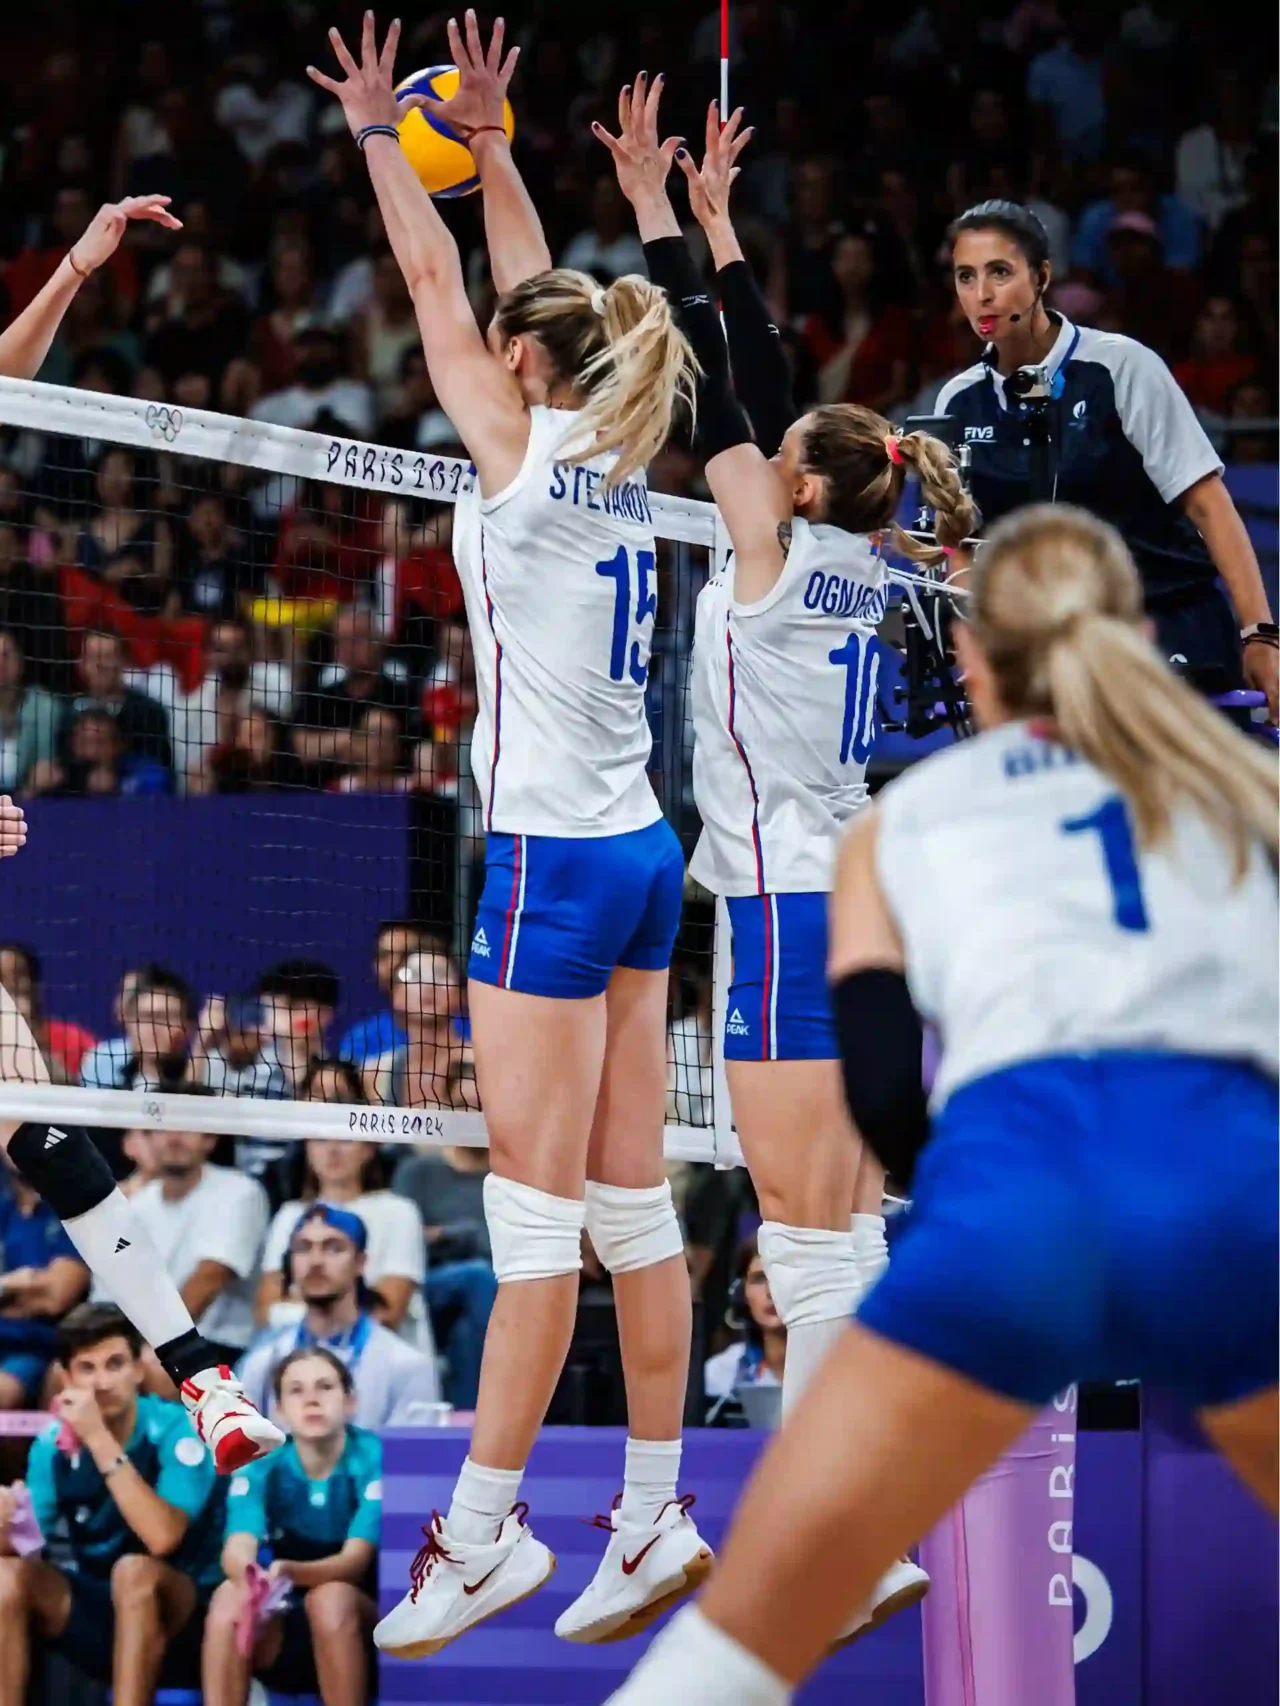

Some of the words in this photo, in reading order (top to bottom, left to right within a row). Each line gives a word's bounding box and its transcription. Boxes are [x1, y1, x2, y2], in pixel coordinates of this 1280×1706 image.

[412, 457, 463, 494] 202
[595, 544, 657, 686] 15
[828, 632, 880, 765] 10
[1060, 794, 1150, 932] 1
[726, 1023, 751, 1036] PEAK
[401, 1115, 444, 1136] 2024
